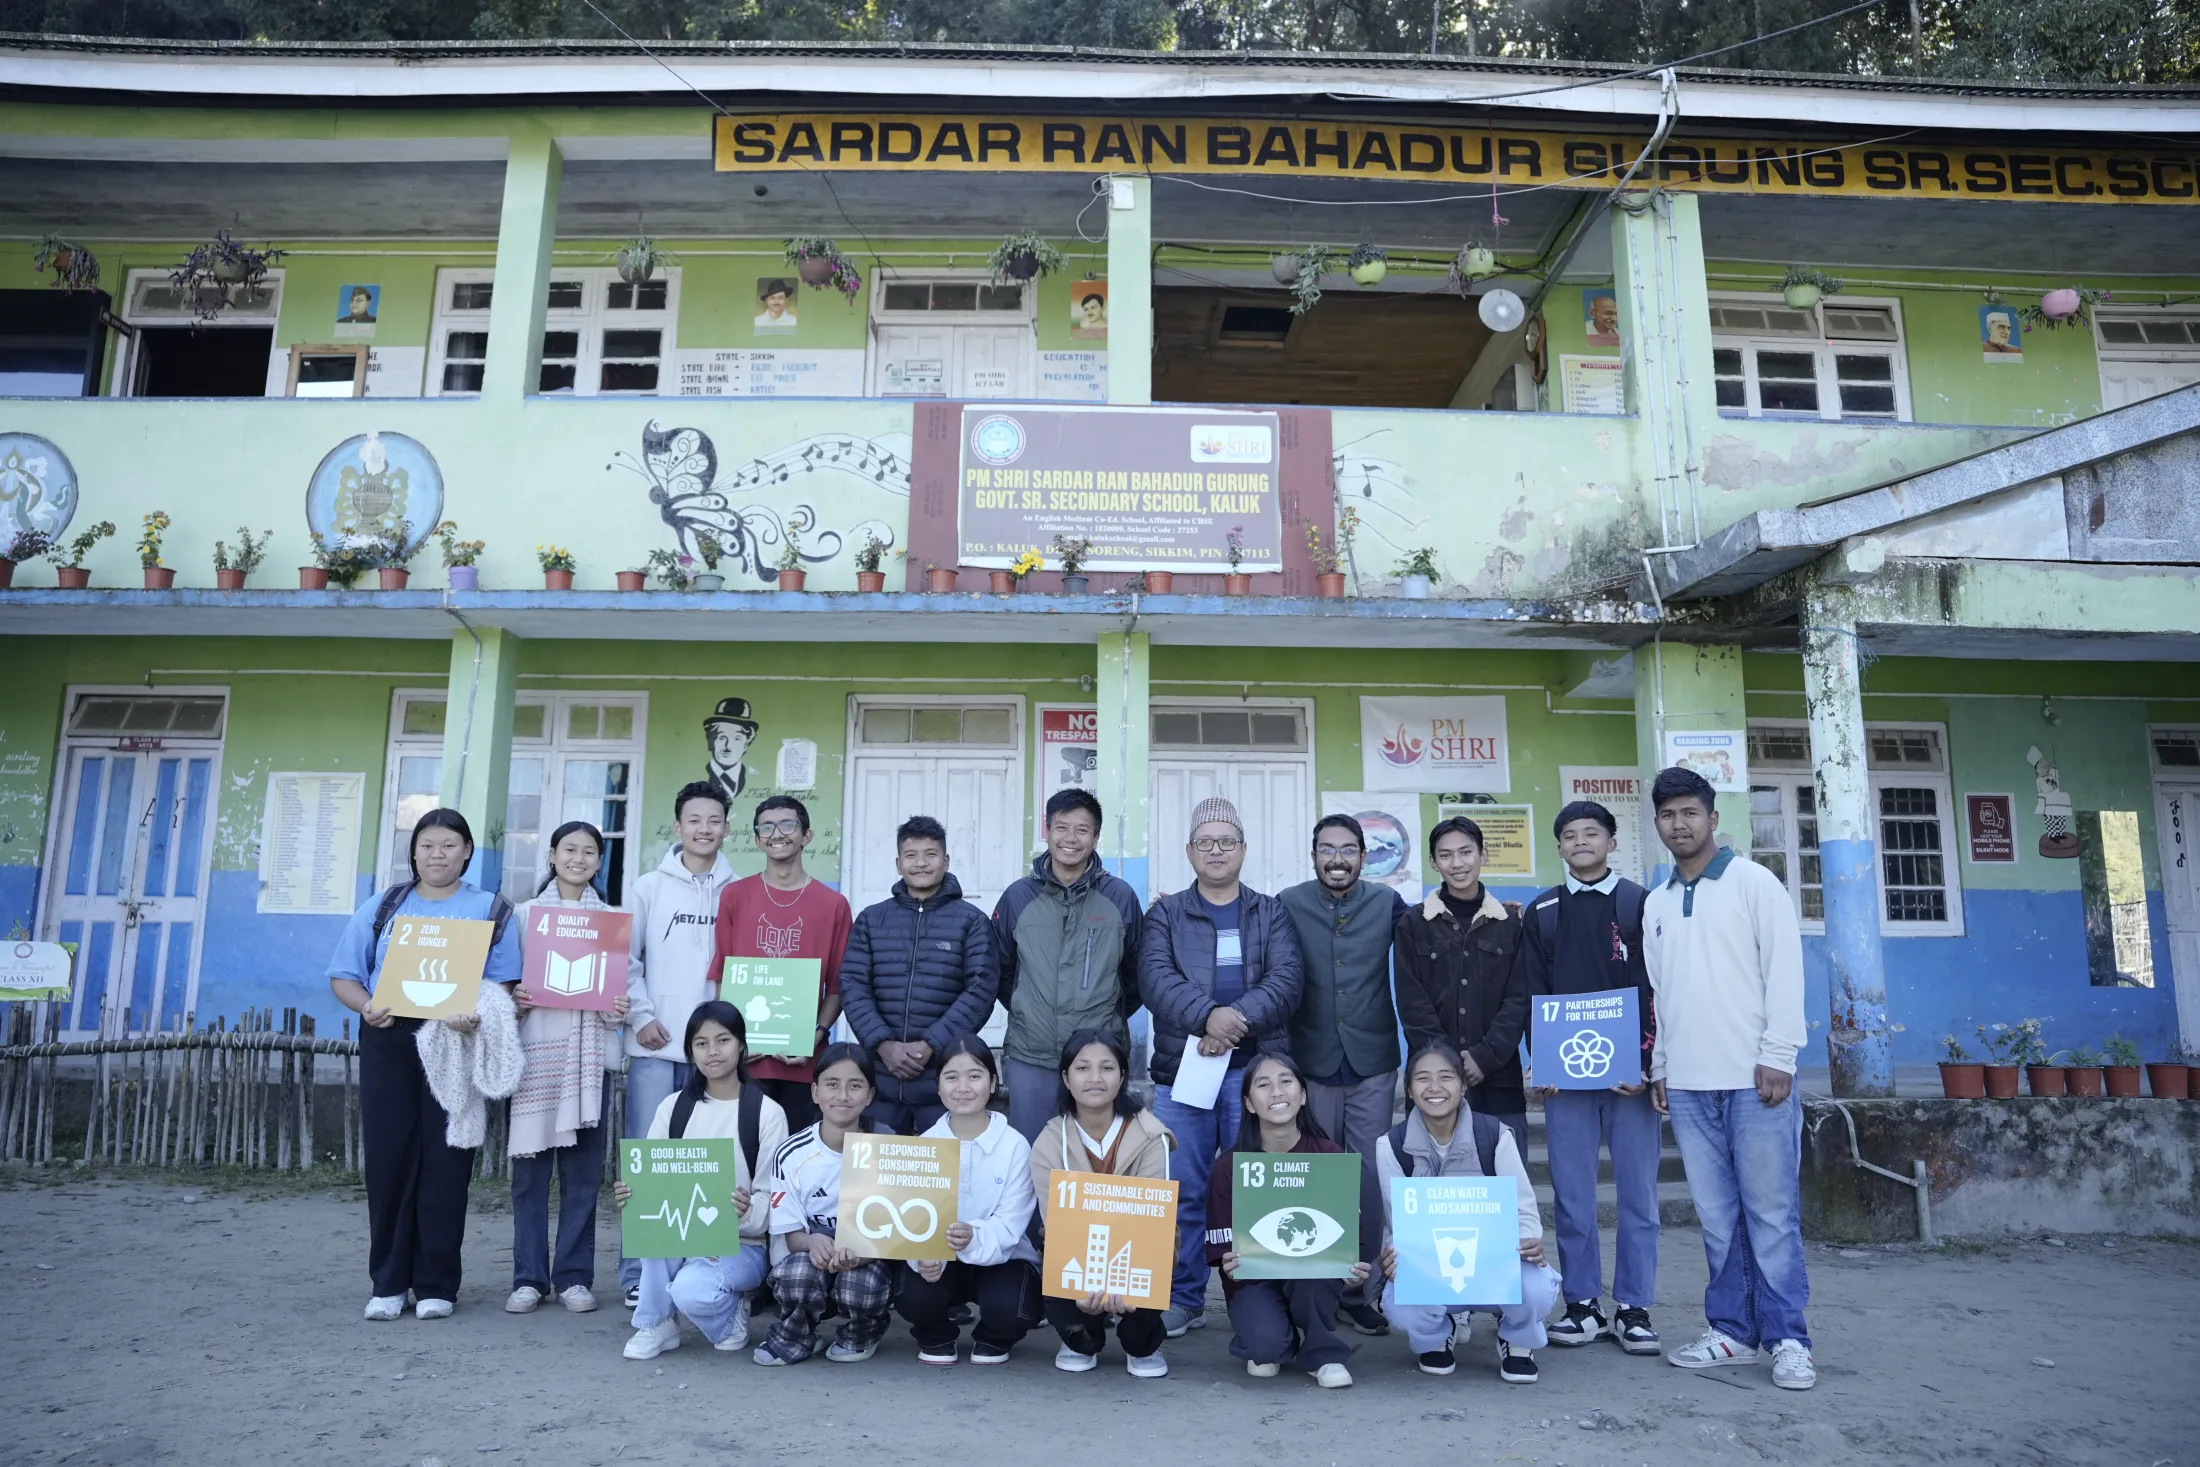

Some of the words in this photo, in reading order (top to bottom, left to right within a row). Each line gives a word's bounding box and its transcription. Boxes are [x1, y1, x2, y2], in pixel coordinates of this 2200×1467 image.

[733, 122, 1020, 165] SARDAR
[1042, 123, 1187, 165] RAN
[1206, 126, 1542, 177] BAHADUR
[1562, 141, 1845, 188] GURUNG
[715, 353, 739, 361] STATE
[750, 353, 775, 361] SIKKIM
[1044, 353, 1095, 361] EDUCATION
[681, 364, 704, 372] STATE
[680, 375, 702, 384] STATE
[680, 386, 702, 395] STATE
[1227, 441, 1266, 453] SHRI
[966, 468, 990, 488] PM
[993, 469, 1029, 489] SHRI
[1032, 470, 1094, 490] SARDAR
[1096, 471, 1128, 490] RAN
[1131, 471, 1203, 492] BAHADUR
[1206, 473, 1269, 493] GURUNG
[975, 489, 1019, 509] GOVT.
[1021, 490, 1047, 510] SR.
[1049, 491, 1140, 512] SECONDARY
[1142, 492, 1207, 515] SCHOOL,
[1210, 494, 1261, 514] KALUK
[1035, 515, 1062, 523] English
[1121, 516, 1147, 525] School,
[1089, 534, 1175, 543] kalukschool@gmail.com
[965, 542, 986, 552] P.O.
[1087, 545, 1142, 557] SORENG,
[1145, 547, 1197, 559] SIKKIM,
[1200, 548, 1222, 557] PIN
[1068, 713, 1097, 730] NO
[1430, 718, 1465, 737] PM
[1430, 737, 1497, 760] SHRI
[1675, 737, 1709, 745] READING
[1710, 737, 1731, 745] ZONE
[1573, 779, 1633, 794] POSITIVE
[536, 913, 550, 936] 4
[557, 914, 590, 927] QUALITY
[398, 923, 413, 945] 2
[420, 924, 440, 935] ZERO
[556, 927, 599, 940] EDUCATION
[417, 936, 448, 948] HUNGER
[730, 963, 748, 985] 15
[754, 964, 769, 974] LIFE
[29, 975, 44, 983] XII
[753, 976, 764, 986] ON
[765, 976, 784, 986] LAND
[1565, 996, 1623, 1011] PARTNERSHIPS
[1541, 1001, 1560, 1022] 17
[1565, 1011, 1581, 1022] FOR
[1582, 1010, 1597, 1021] THE
[1597, 1008, 1623, 1020] GOALS
[650, 1147, 674, 1159] GOOD
[676, 1147, 708, 1159] HEALTH
[851, 1142, 873, 1169] 12
[879, 1143, 937, 1159] RESPONSIBLE
[630, 1147, 643, 1174] 3
[651, 1162, 669, 1174] AND
[670, 1161, 719, 1174] WELL-BEING
[878, 1158, 940, 1174] CONSUMPTION
[1273, 1162, 1310, 1173] CLIMATE
[877, 1174, 895, 1186] AND
[896, 1175, 951, 1190] PRODUCTION
[1239, 1161, 1265, 1188] 13
[1272, 1177, 1305, 1188] ACTION
[1057, 1180, 1077, 1209] 11
[1083, 1182, 1144, 1200] SUSTAINABLE
[1144, 1188, 1173, 1203] CITIES
[1427, 1187, 1457, 1199] CLEAN
[1458, 1186, 1488, 1199] WATER
[1082, 1198, 1102, 1211] AND
[1103, 1200, 1165, 1218] COMMUNITIES
[1404, 1187, 1418, 1215] 6
[1428, 1202, 1447, 1215] AND
[1448, 1202, 1501, 1215] SANITATION
[1204, 1227, 1233, 1245] PUMA
